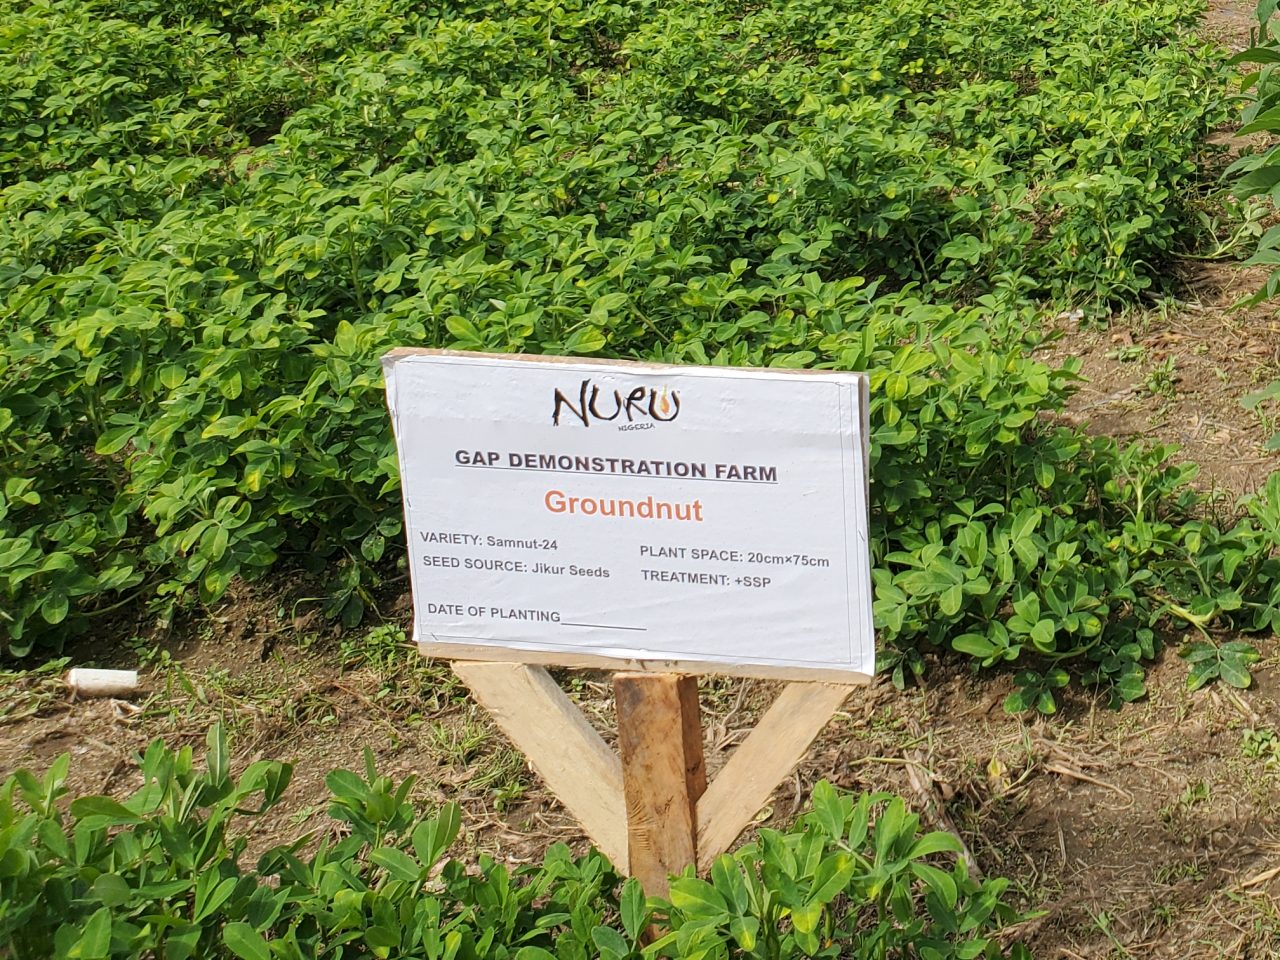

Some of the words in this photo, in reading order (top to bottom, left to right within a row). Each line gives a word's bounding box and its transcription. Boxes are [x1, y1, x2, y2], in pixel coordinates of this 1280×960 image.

[552, 378, 681, 427] NURU
[618, 422, 656, 432] NIGERIA
[455, 449, 500, 467] GAP
[509, 452, 707, 478] DEMONSTRATION
[715, 463, 777, 482] FARM
[544, 489, 703, 522] Groundnut
[420, 531, 483, 546] VARIETY:
[487, 535, 558, 551] Samnut-24
[640, 545, 687, 559] PLANT
[691, 548, 743, 563] SPACE:
[423, 555, 460, 568] SEED
[464, 558, 528, 573] SOURCE:
[531, 562, 565, 576] Jikur
[569, 565, 610, 578] Seeds
[641, 569, 731, 586] TREATMENT:
[734, 575, 772, 588] +SSP
[427, 603, 464, 616] DATE
[467, 605, 486, 618] OF
